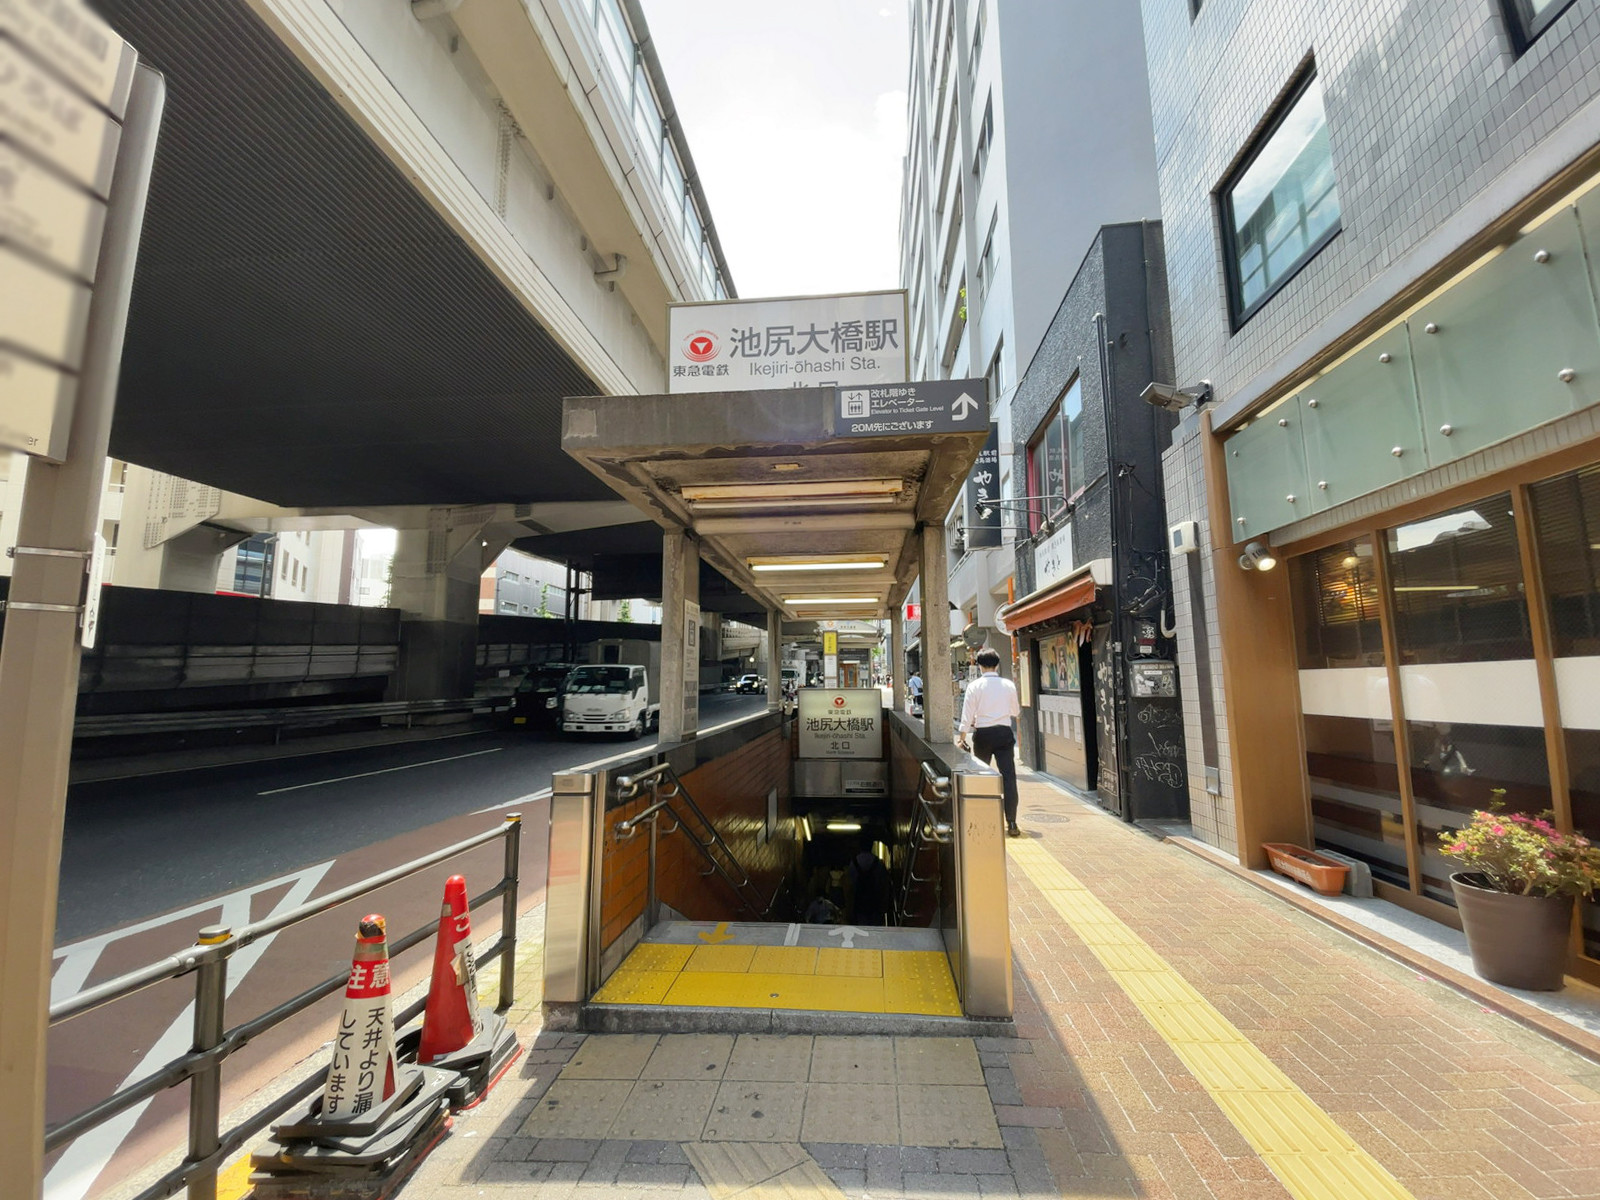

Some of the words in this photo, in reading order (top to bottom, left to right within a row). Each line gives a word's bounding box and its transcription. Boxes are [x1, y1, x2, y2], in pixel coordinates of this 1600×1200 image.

[729, 318, 899, 359] 池尻大橋駅
[673, 364, 730, 377] 東急電鉄
[749, 357, 845, 377] Ikejiri-ōhashi
[850, 356, 881, 371] Sta.
[870, 388, 916, 399] 改札階ゆき
[871, 398, 925, 408] エレベーター
[851, 420, 934, 433] 20M先にございます
[806, 717, 874, 731] 池尻大橋駅
[831, 741, 850, 750] 北口
[327, 1009, 357, 1114] しています
[352, 1007, 385, 1114] 天井より漏
